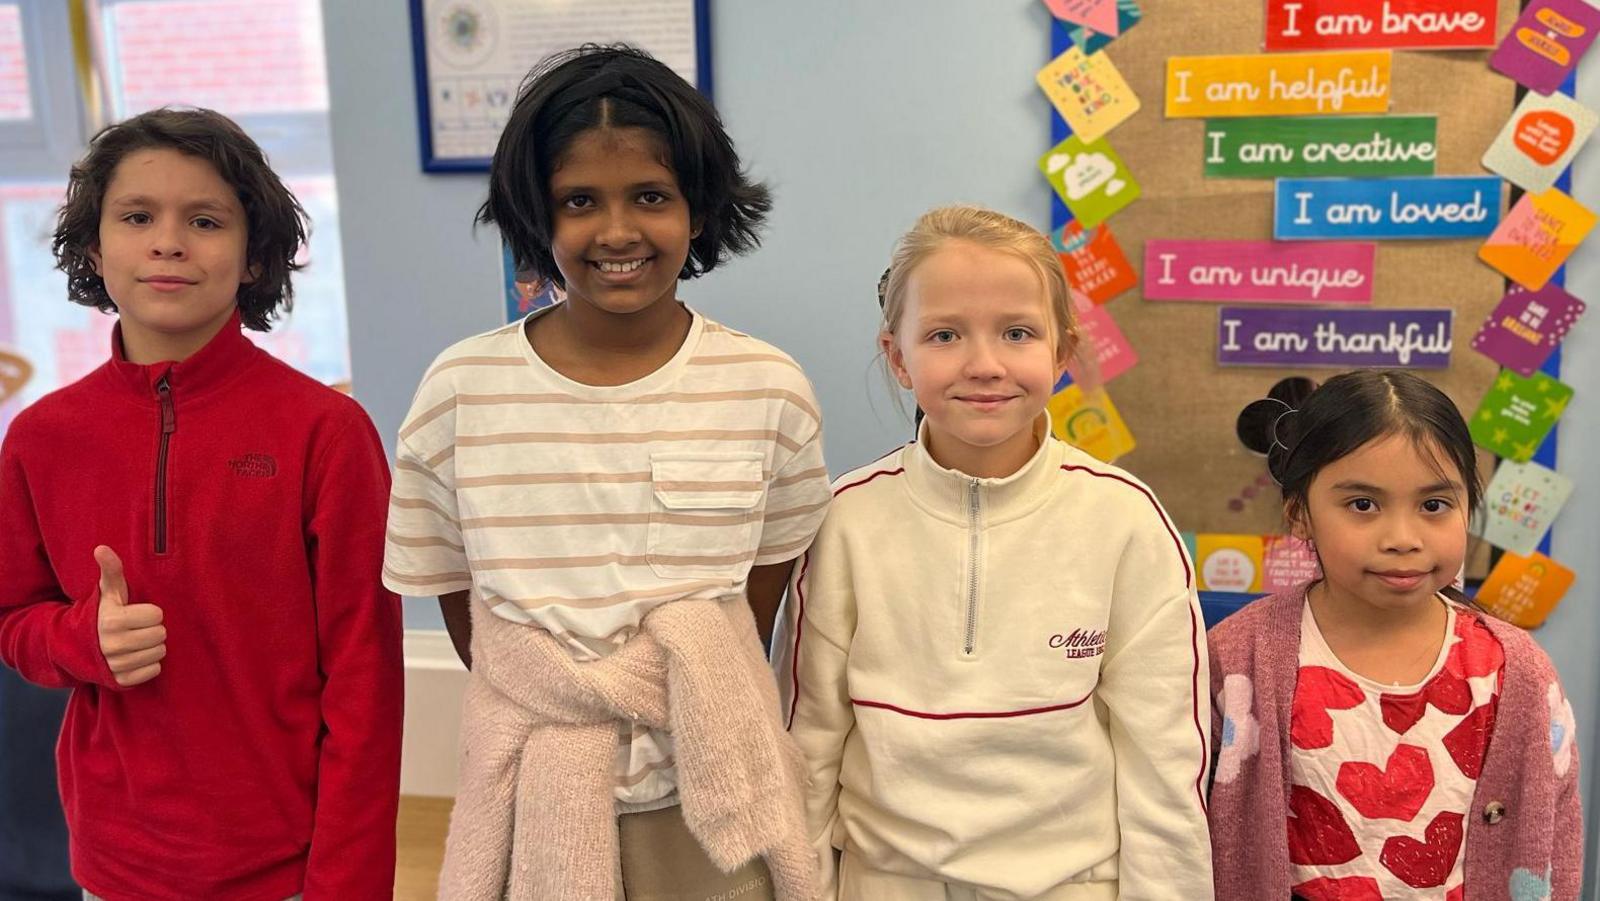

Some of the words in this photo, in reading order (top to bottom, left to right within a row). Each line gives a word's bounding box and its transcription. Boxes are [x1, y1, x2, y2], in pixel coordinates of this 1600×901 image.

[1282, 3, 1302, 36] I
[1315, 14, 1373, 36] am
[1381, 1, 1486, 33] brave
[1174, 70, 1192, 103] I
[1205, 81, 1260, 102] am
[1269, 66, 1387, 110] helpful
[1207, 131, 1226, 163] I
[1238, 143, 1294, 163] am
[1302, 132, 1436, 163] creative
[1293, 192, 1313, 225] I
[1326, 204, 1382, 224] am
[1390, 191, 1488, 223] loved
[1158, 253, 1177, 285] I
[1189, 266, 1243, 286] am
[1251, 263, 1365, 298] unique
[1222, 320, 1241, 351] I
[1254, 332, 1308, 352] am
[1314, 321, 1451, 364] thankful
[1268, 568, 1314, 578] FANTASTIC
[1066, 648, 1094, 658] LEAGUE
